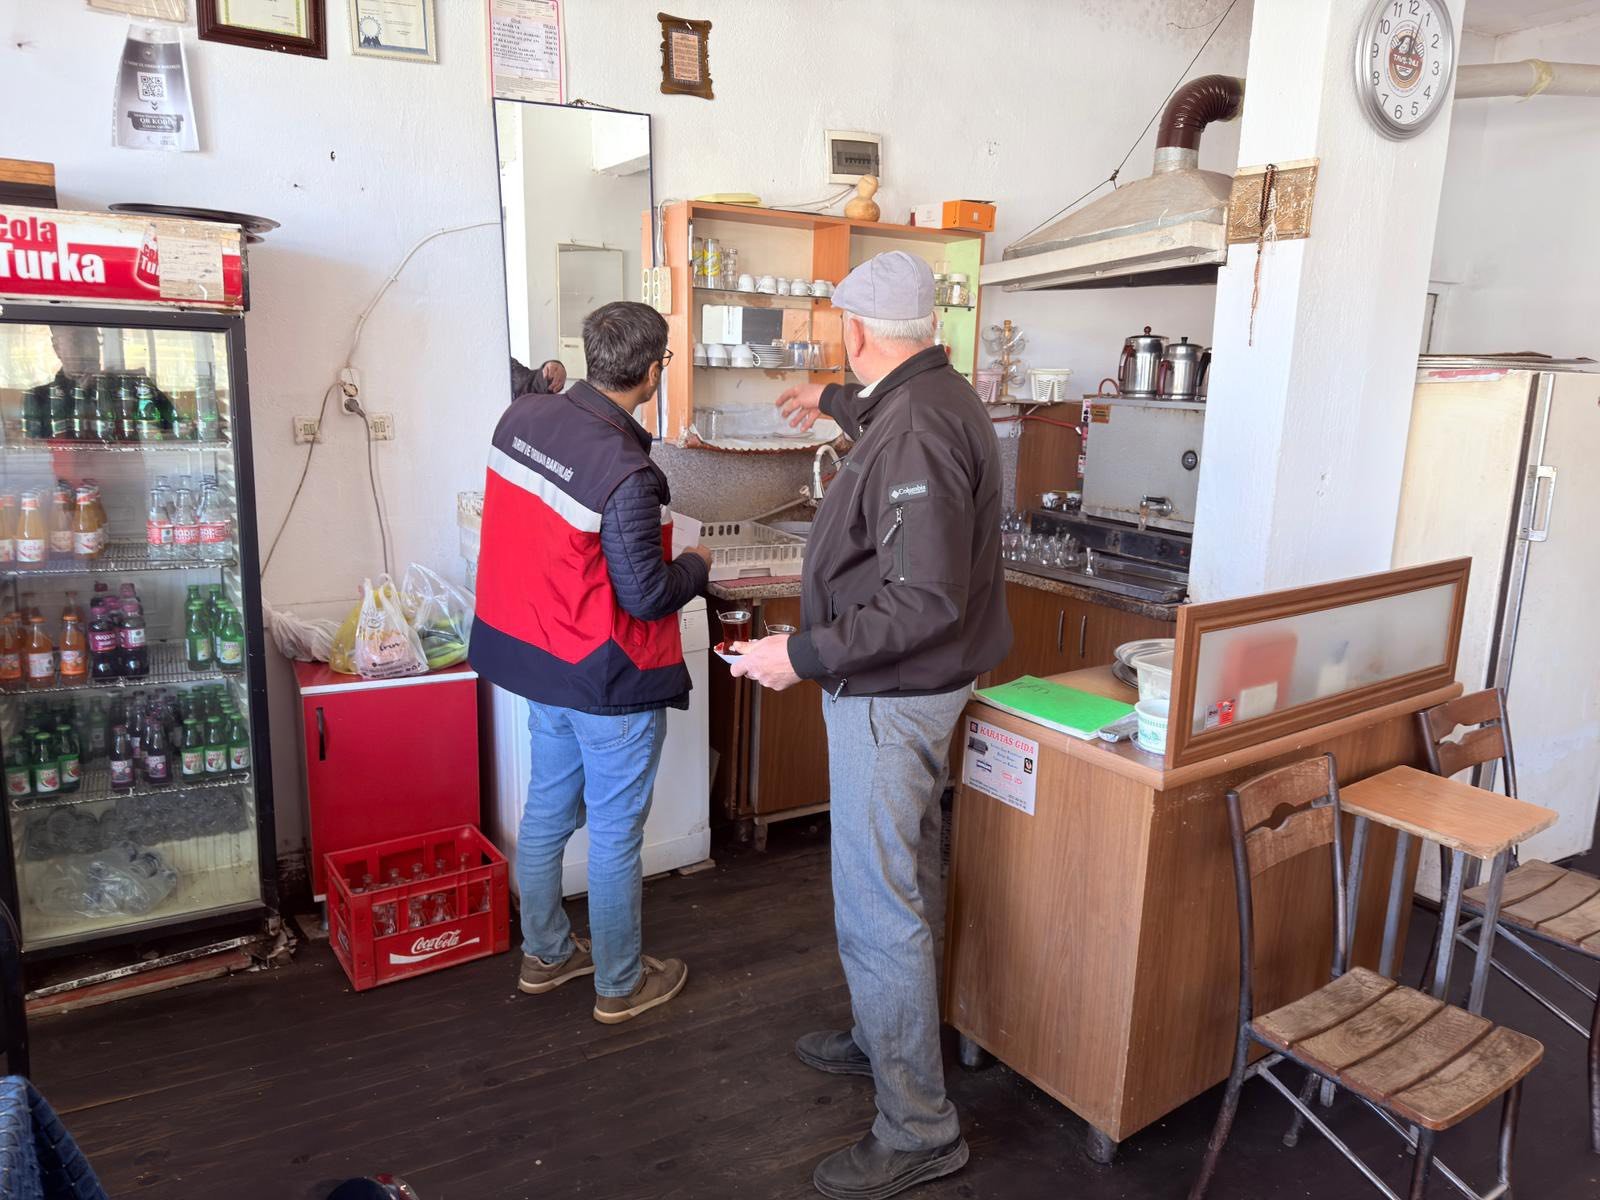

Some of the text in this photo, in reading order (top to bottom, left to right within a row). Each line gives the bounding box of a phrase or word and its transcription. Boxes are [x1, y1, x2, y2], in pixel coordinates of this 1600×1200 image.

[1393, 2, 1403, 18] 11
[1409, 0, 1420, 16] 12
[1380, 18, 1391, 36] 10
[1426, 12, 1431, 27] 1
[1431, 33, 1440, 49] 2
[1372, 42, 1379, 59] 9
[1431, 60, 1440, 76] 3
[1373, 70, 1380, 86] 8
[1381, 93, 1389, 107] 7
[1423, 85, 1431, 100] 4
[1394, 104, 1403, 119] 6
[1411, 101, 1419, 116] 5
